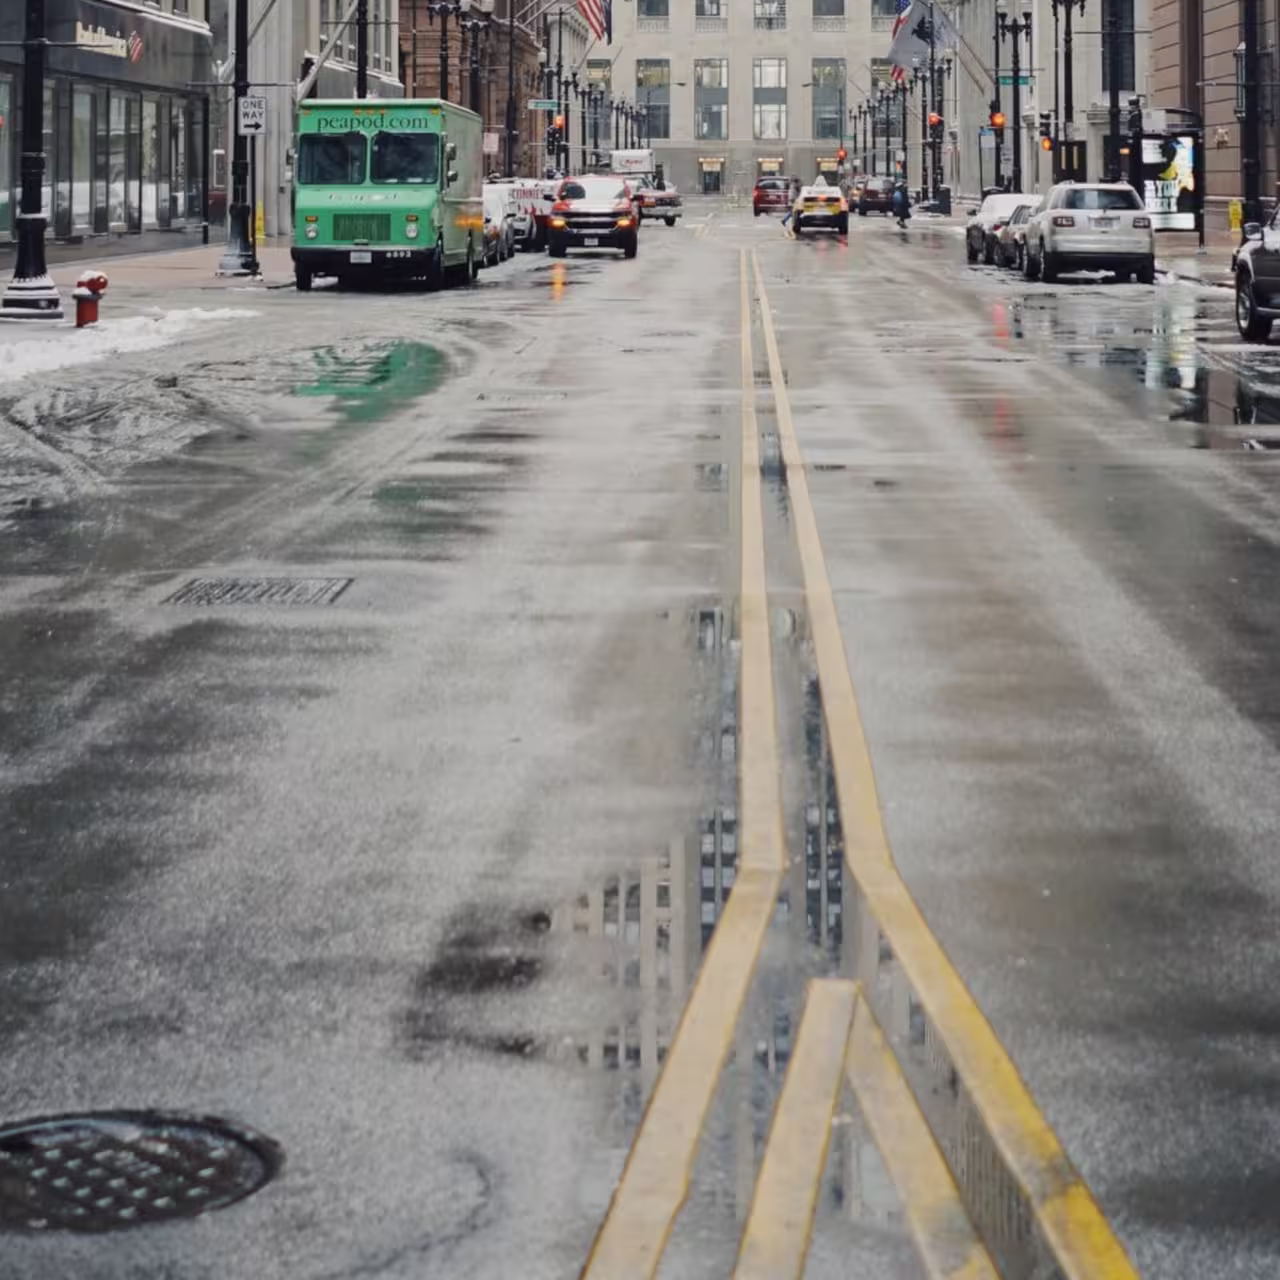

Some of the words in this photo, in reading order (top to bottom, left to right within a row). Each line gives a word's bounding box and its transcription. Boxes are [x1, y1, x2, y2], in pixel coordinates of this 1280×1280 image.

[243, 100, 264, 110] ONE
[242, 111, 264, 120] WAY
[317, 113, 428, 131] peapod.com
